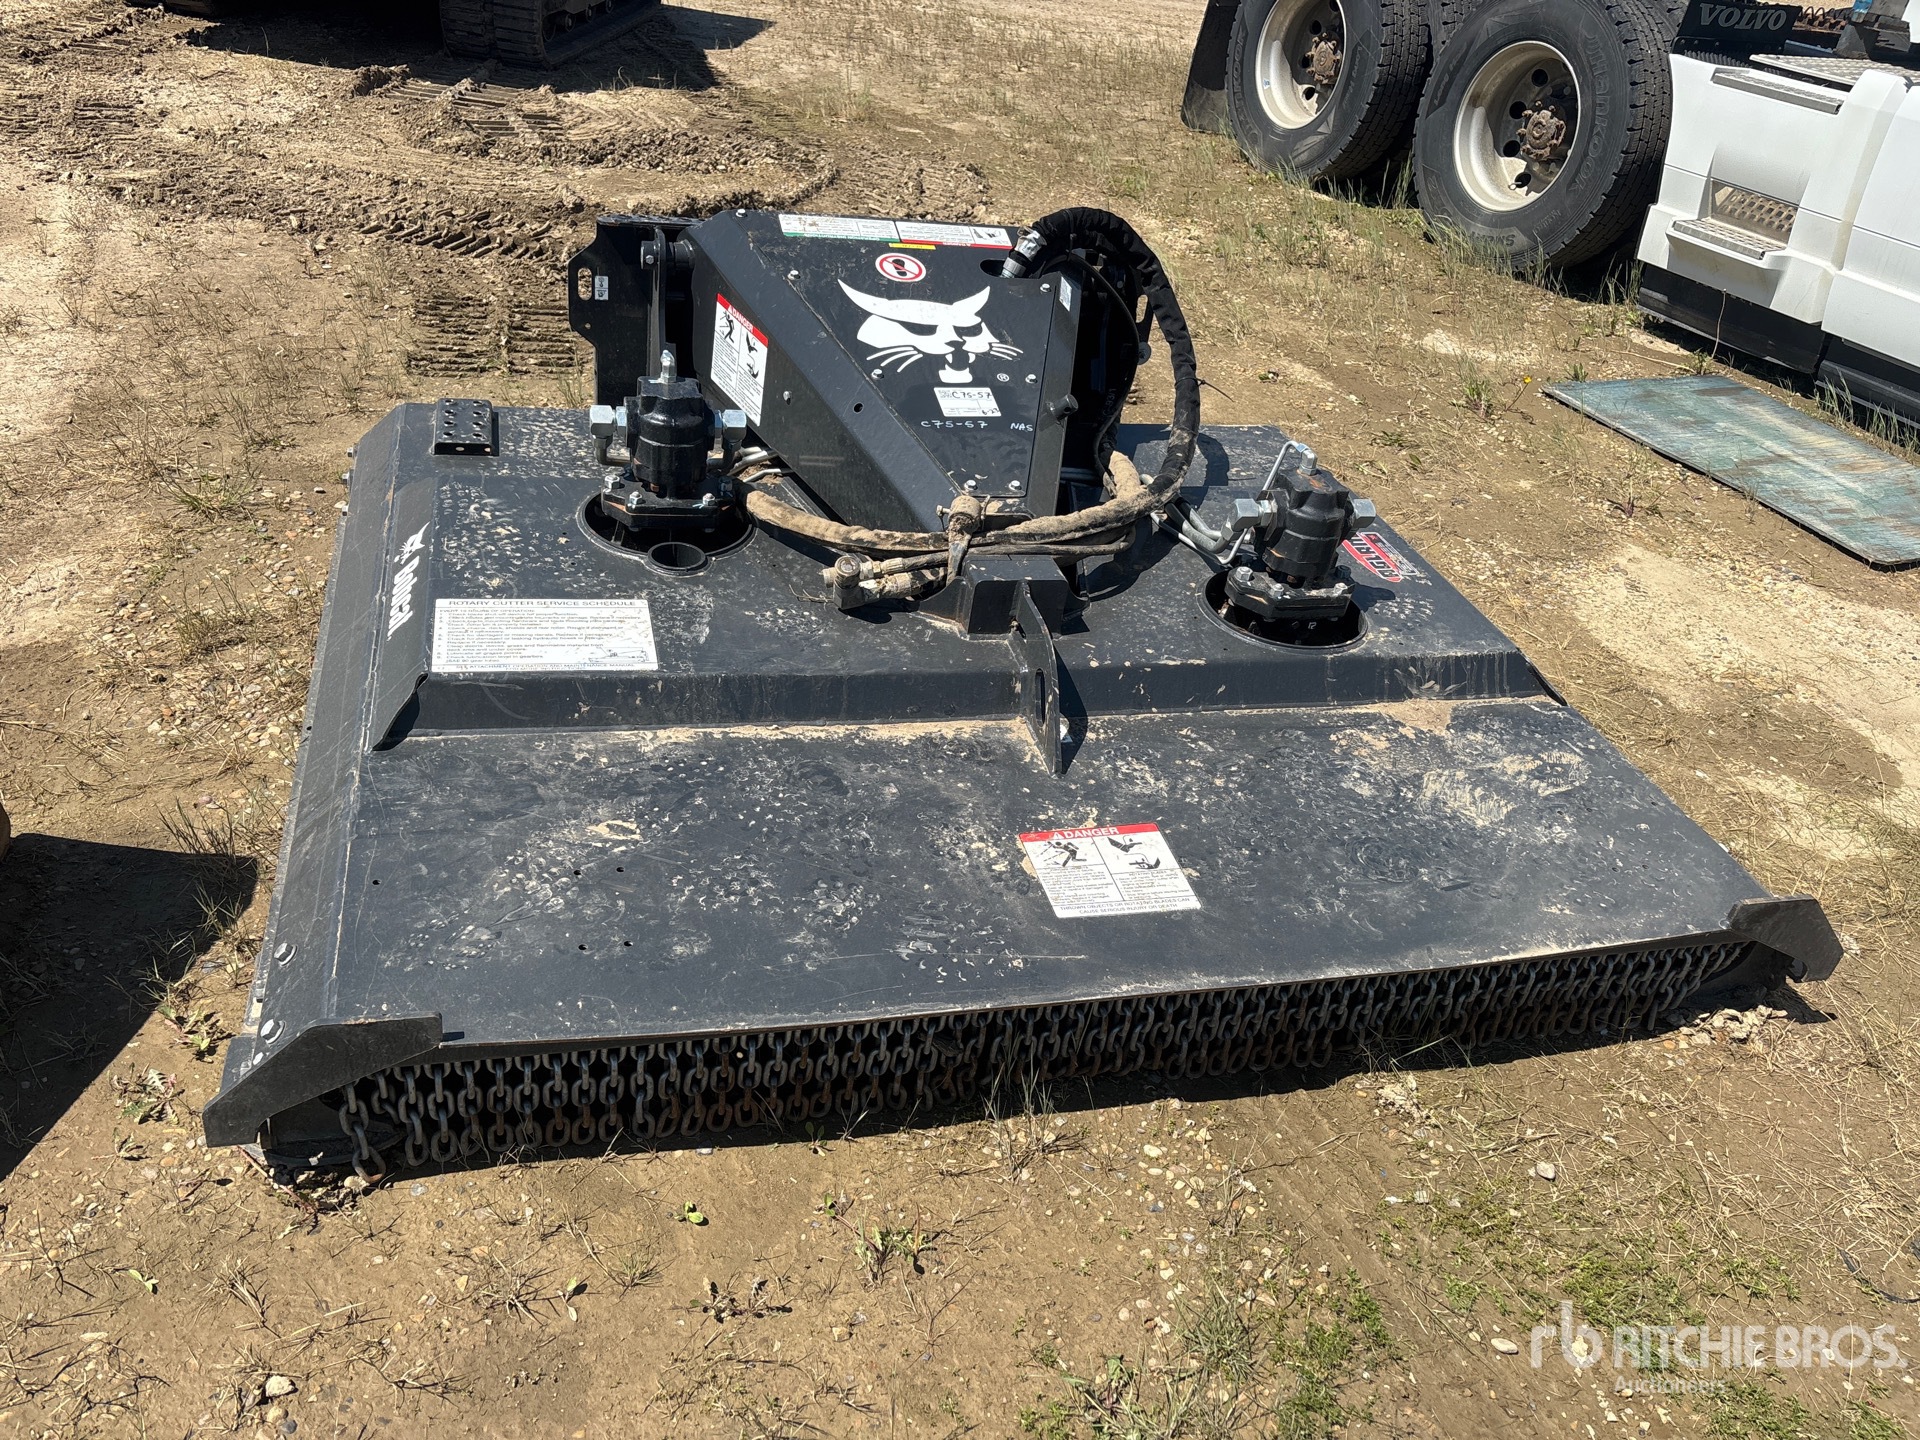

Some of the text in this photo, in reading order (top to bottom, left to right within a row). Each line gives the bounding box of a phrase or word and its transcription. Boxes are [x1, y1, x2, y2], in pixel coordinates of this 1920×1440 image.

[1700, 4, 1786, 31] VOLVO
[732, 308, 754, 333] DANGER
[920, 420, 1034, 432] C75-57 NAS
[387, 555, 420, 637] Bobcat
[1063, 827, 1119, 838] DANGER
